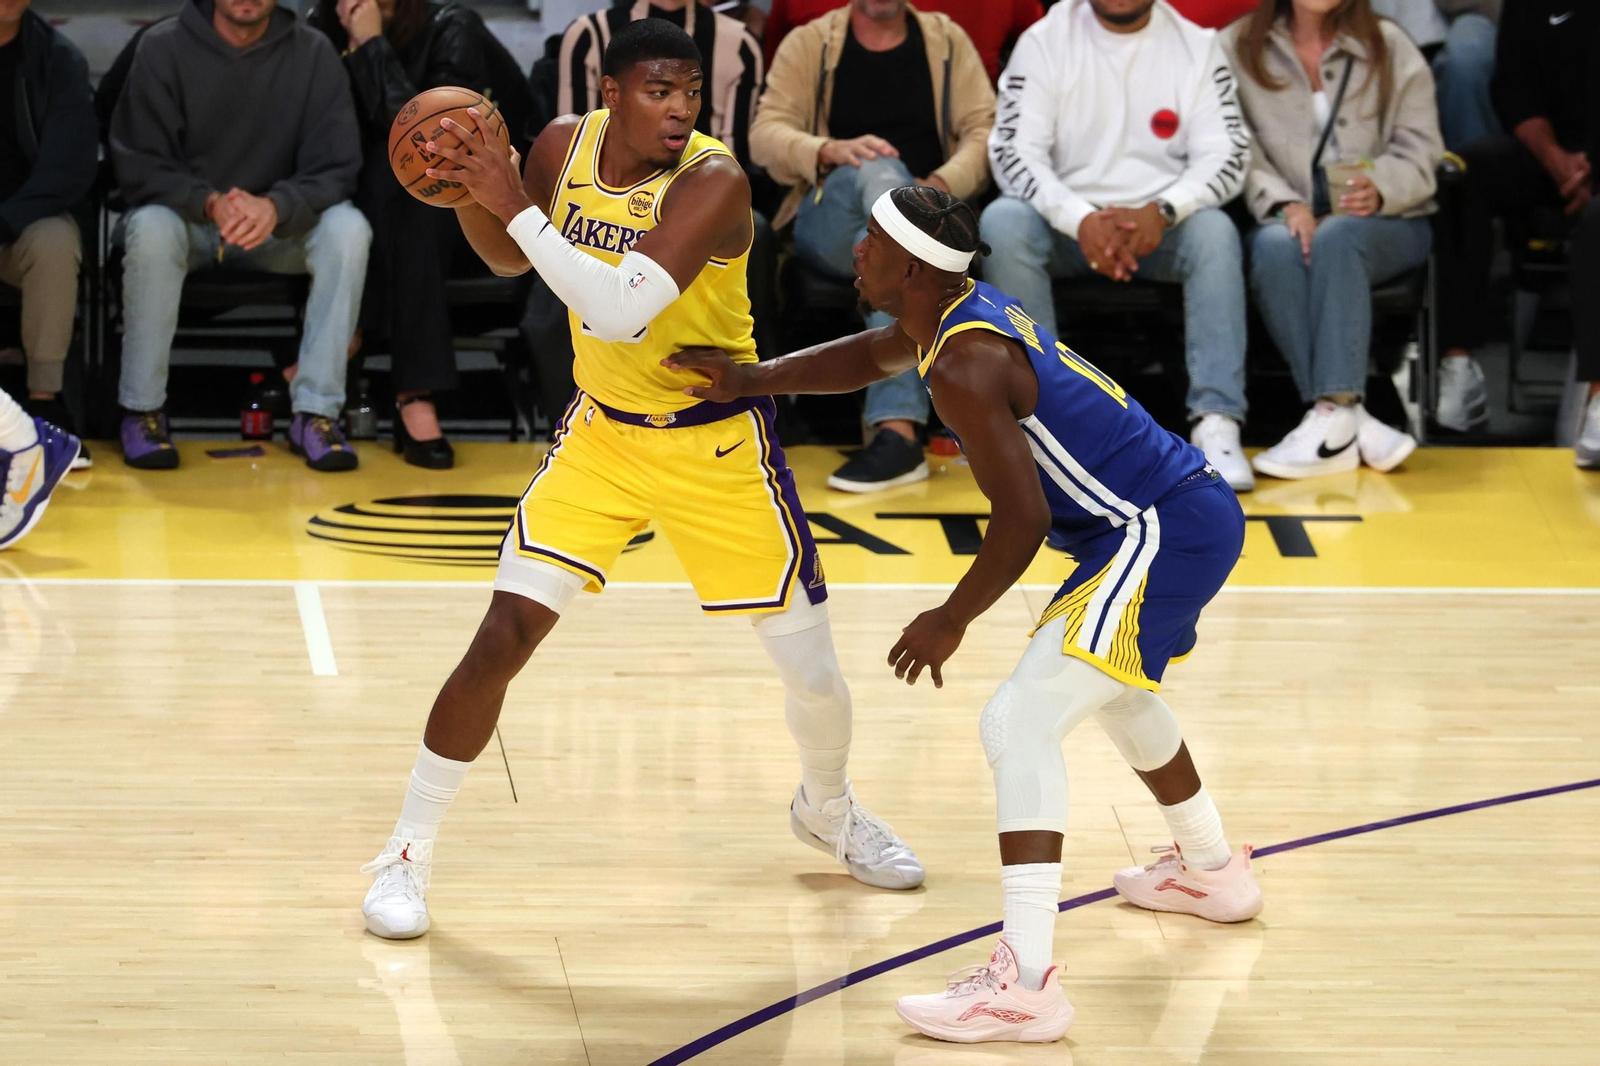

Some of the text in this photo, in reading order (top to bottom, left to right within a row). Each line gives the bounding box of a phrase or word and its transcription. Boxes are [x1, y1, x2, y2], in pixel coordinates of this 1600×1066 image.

[631, 197, 653, 211] bibigo
[1054, 340, 1128, 410] 10
[803, 512, 1364, 558] ATT
